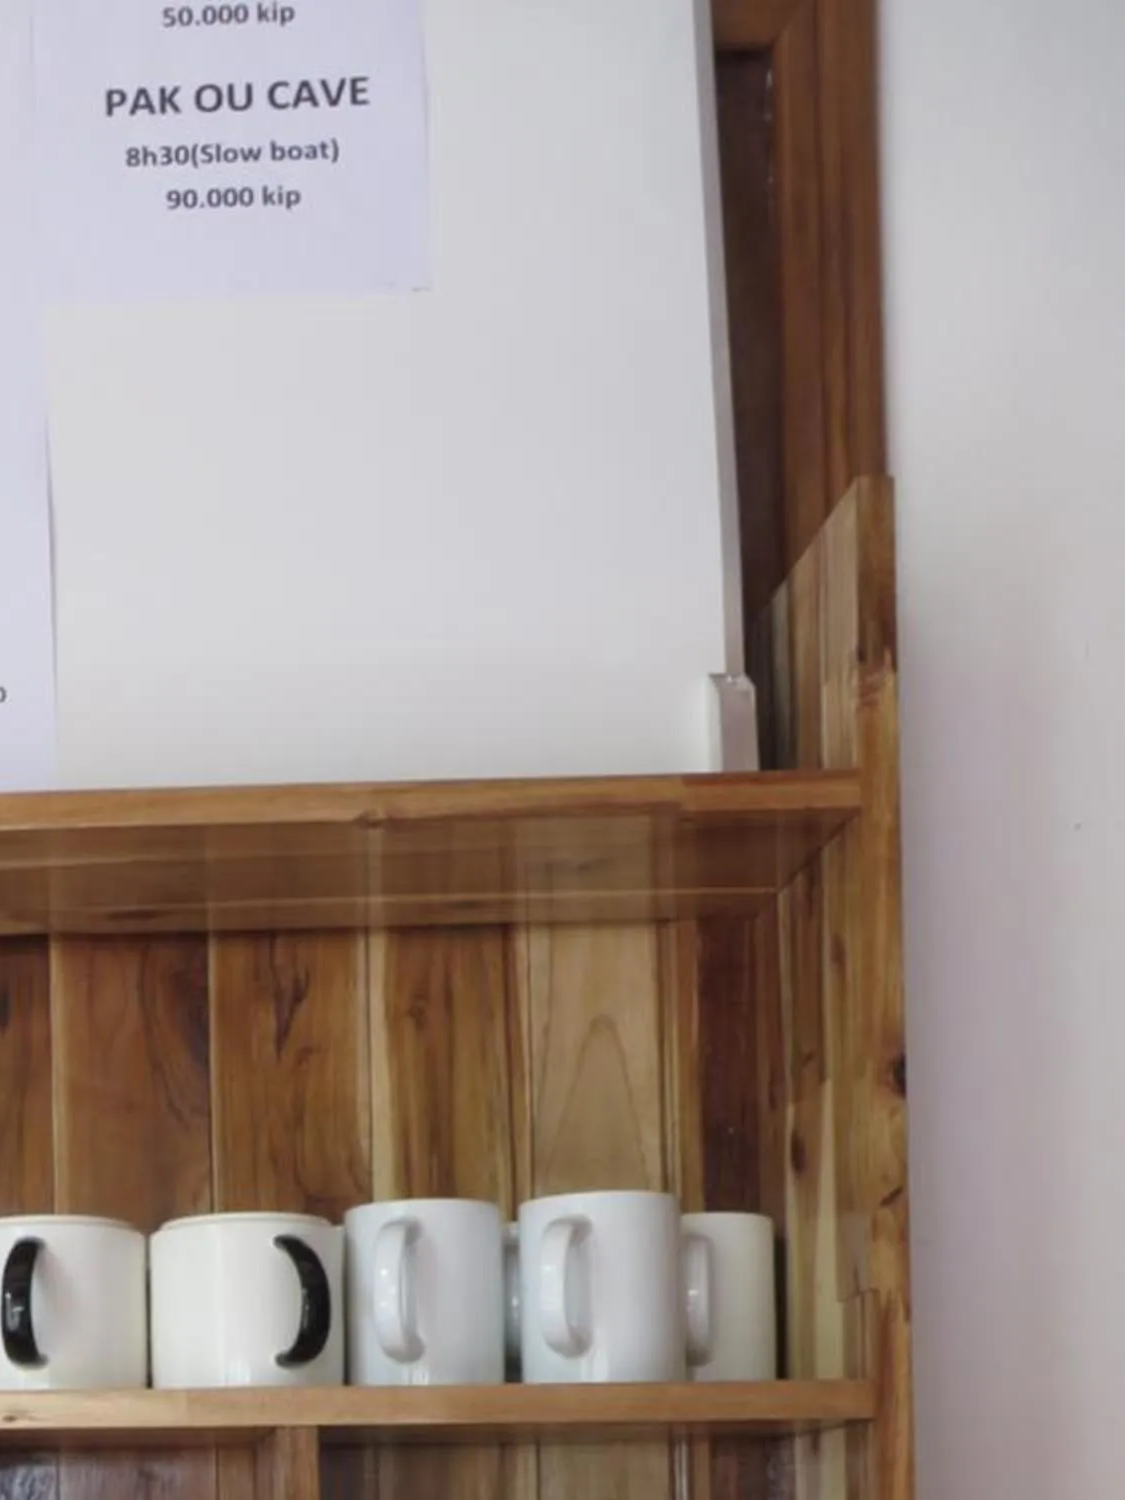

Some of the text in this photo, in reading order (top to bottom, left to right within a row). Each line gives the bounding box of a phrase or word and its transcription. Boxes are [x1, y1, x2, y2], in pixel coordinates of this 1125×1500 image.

[162, 0, 296, 28] 50.000 kip
[105, 76, 370, 118] PAK OU CAVE
[125, 137, 340, 169] 8h30(Slow boat)
[165, 185, 302, 211] 90.000 kip
